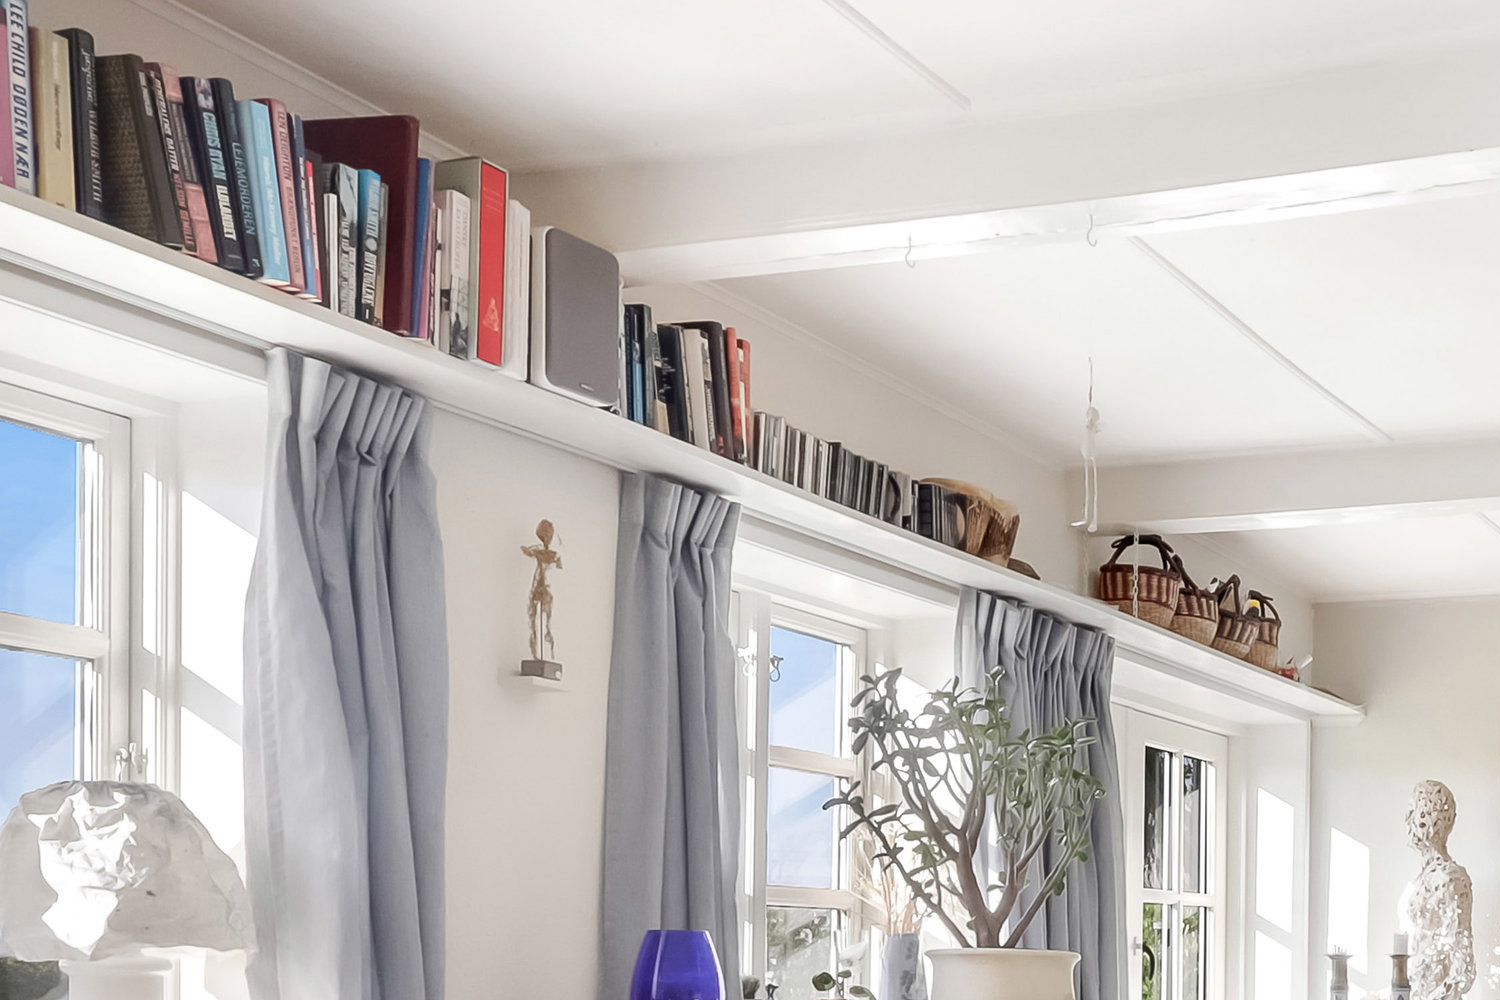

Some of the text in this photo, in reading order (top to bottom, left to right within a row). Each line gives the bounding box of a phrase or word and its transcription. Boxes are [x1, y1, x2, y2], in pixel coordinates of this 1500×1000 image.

[9, 2, 24, 31] LEE
[11, 32, 26, 78] CHILD
[88, 109, 101, 158] WILBUR
[203, 112, 226, 180] CHRIS RYAN
[15, 141, 30, 179] NÆR
[91, 159, 102, 203] SMITH
[232, 142, 256, 236] LEJEMORDEREN
